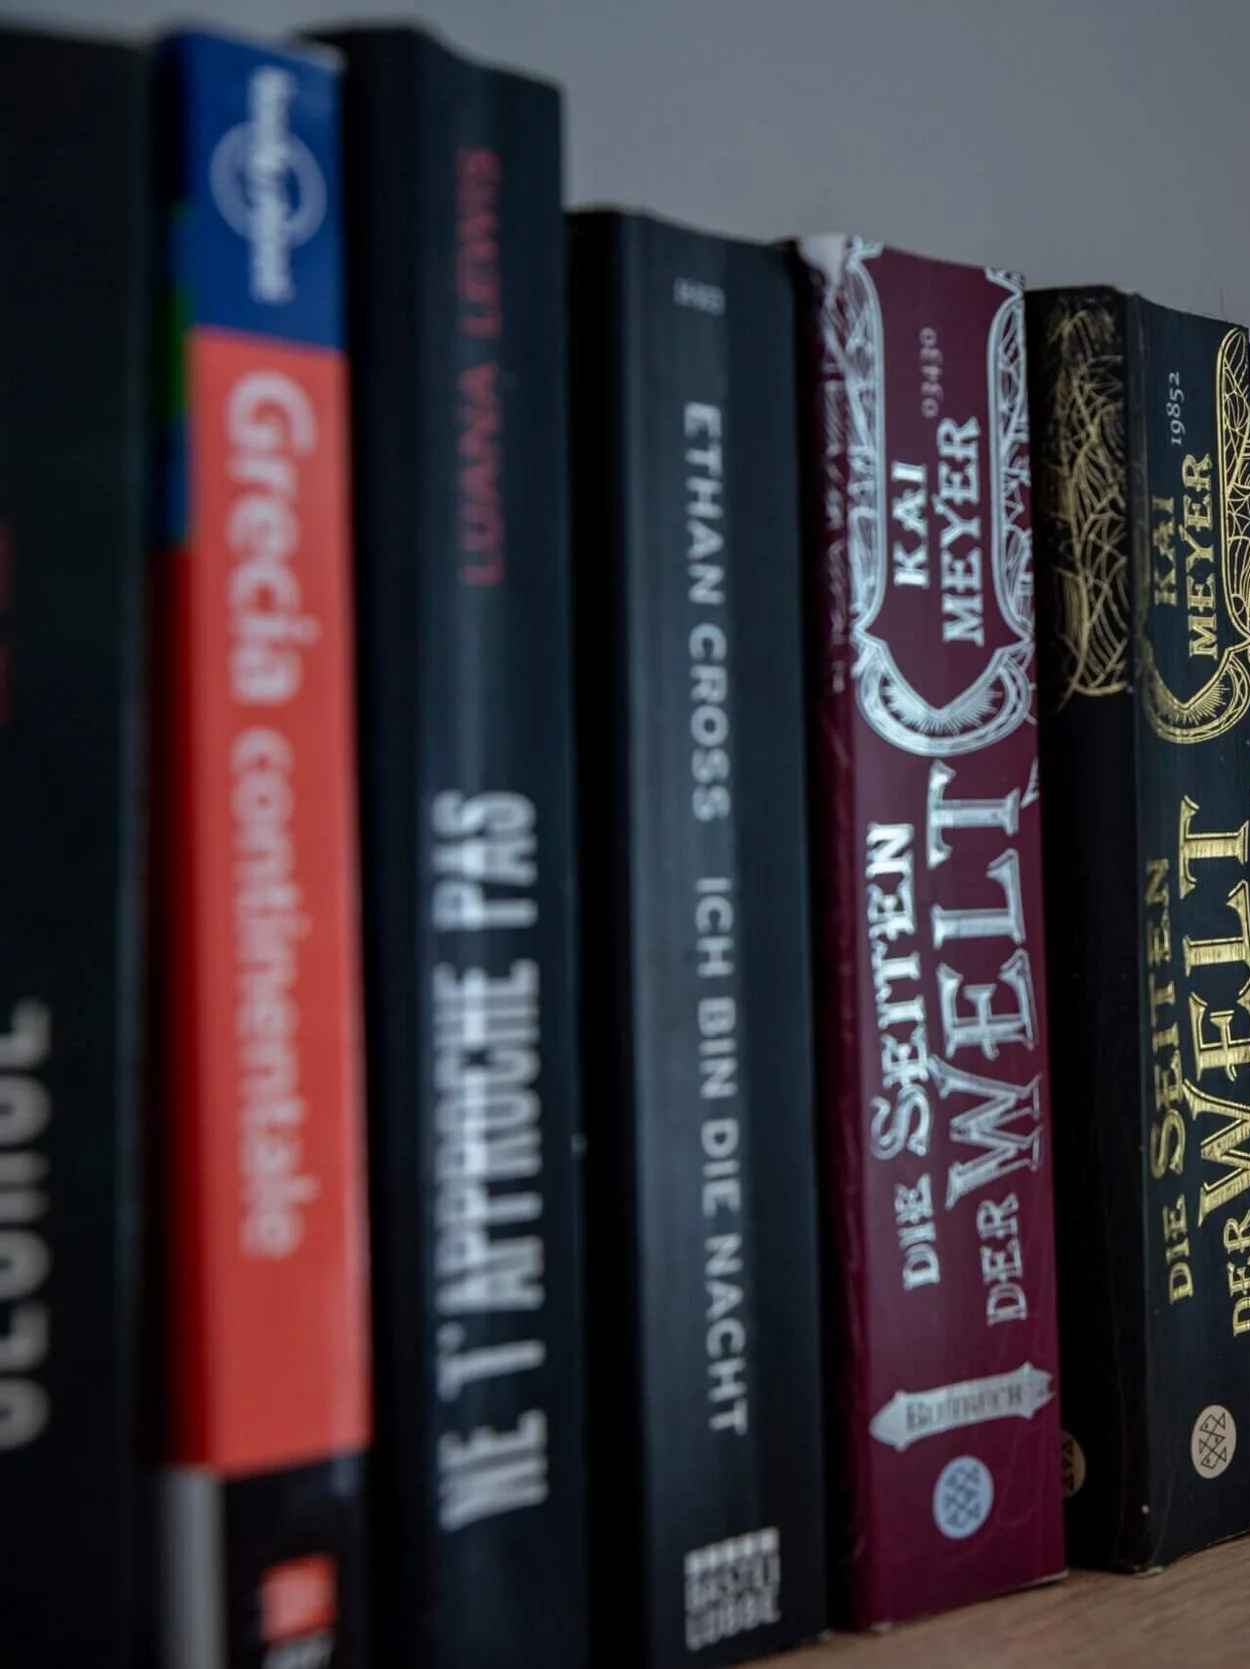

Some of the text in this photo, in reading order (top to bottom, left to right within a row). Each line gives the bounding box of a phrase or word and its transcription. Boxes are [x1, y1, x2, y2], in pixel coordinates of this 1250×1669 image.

[454, 146, 507, 588] LUANA LEWIS
[1165, 371, 1186, 446] 19852
[226, 369, 317, 707] Grecia
[890, 461, 931, 589] KAI
[936, 415, 985, 647] MEYER
[1153, 496, 1178, 606] KAI
[1181, 451, 1218, 661] MEYER
[231, 724, 322, 1259] continentale
[430, 785, 541, 932] PAS
[682, 401, 750, 1436] ETHAN CROSS ICH BIN DIE NACHT
[865, 823, 940, 1291] DIE SEITEN
[926, 758, 1040, 1326] DER WELT
[1145, 858, 1193, 1307] DIE SEITEN
[437, 1408, 550, 1532] NE
